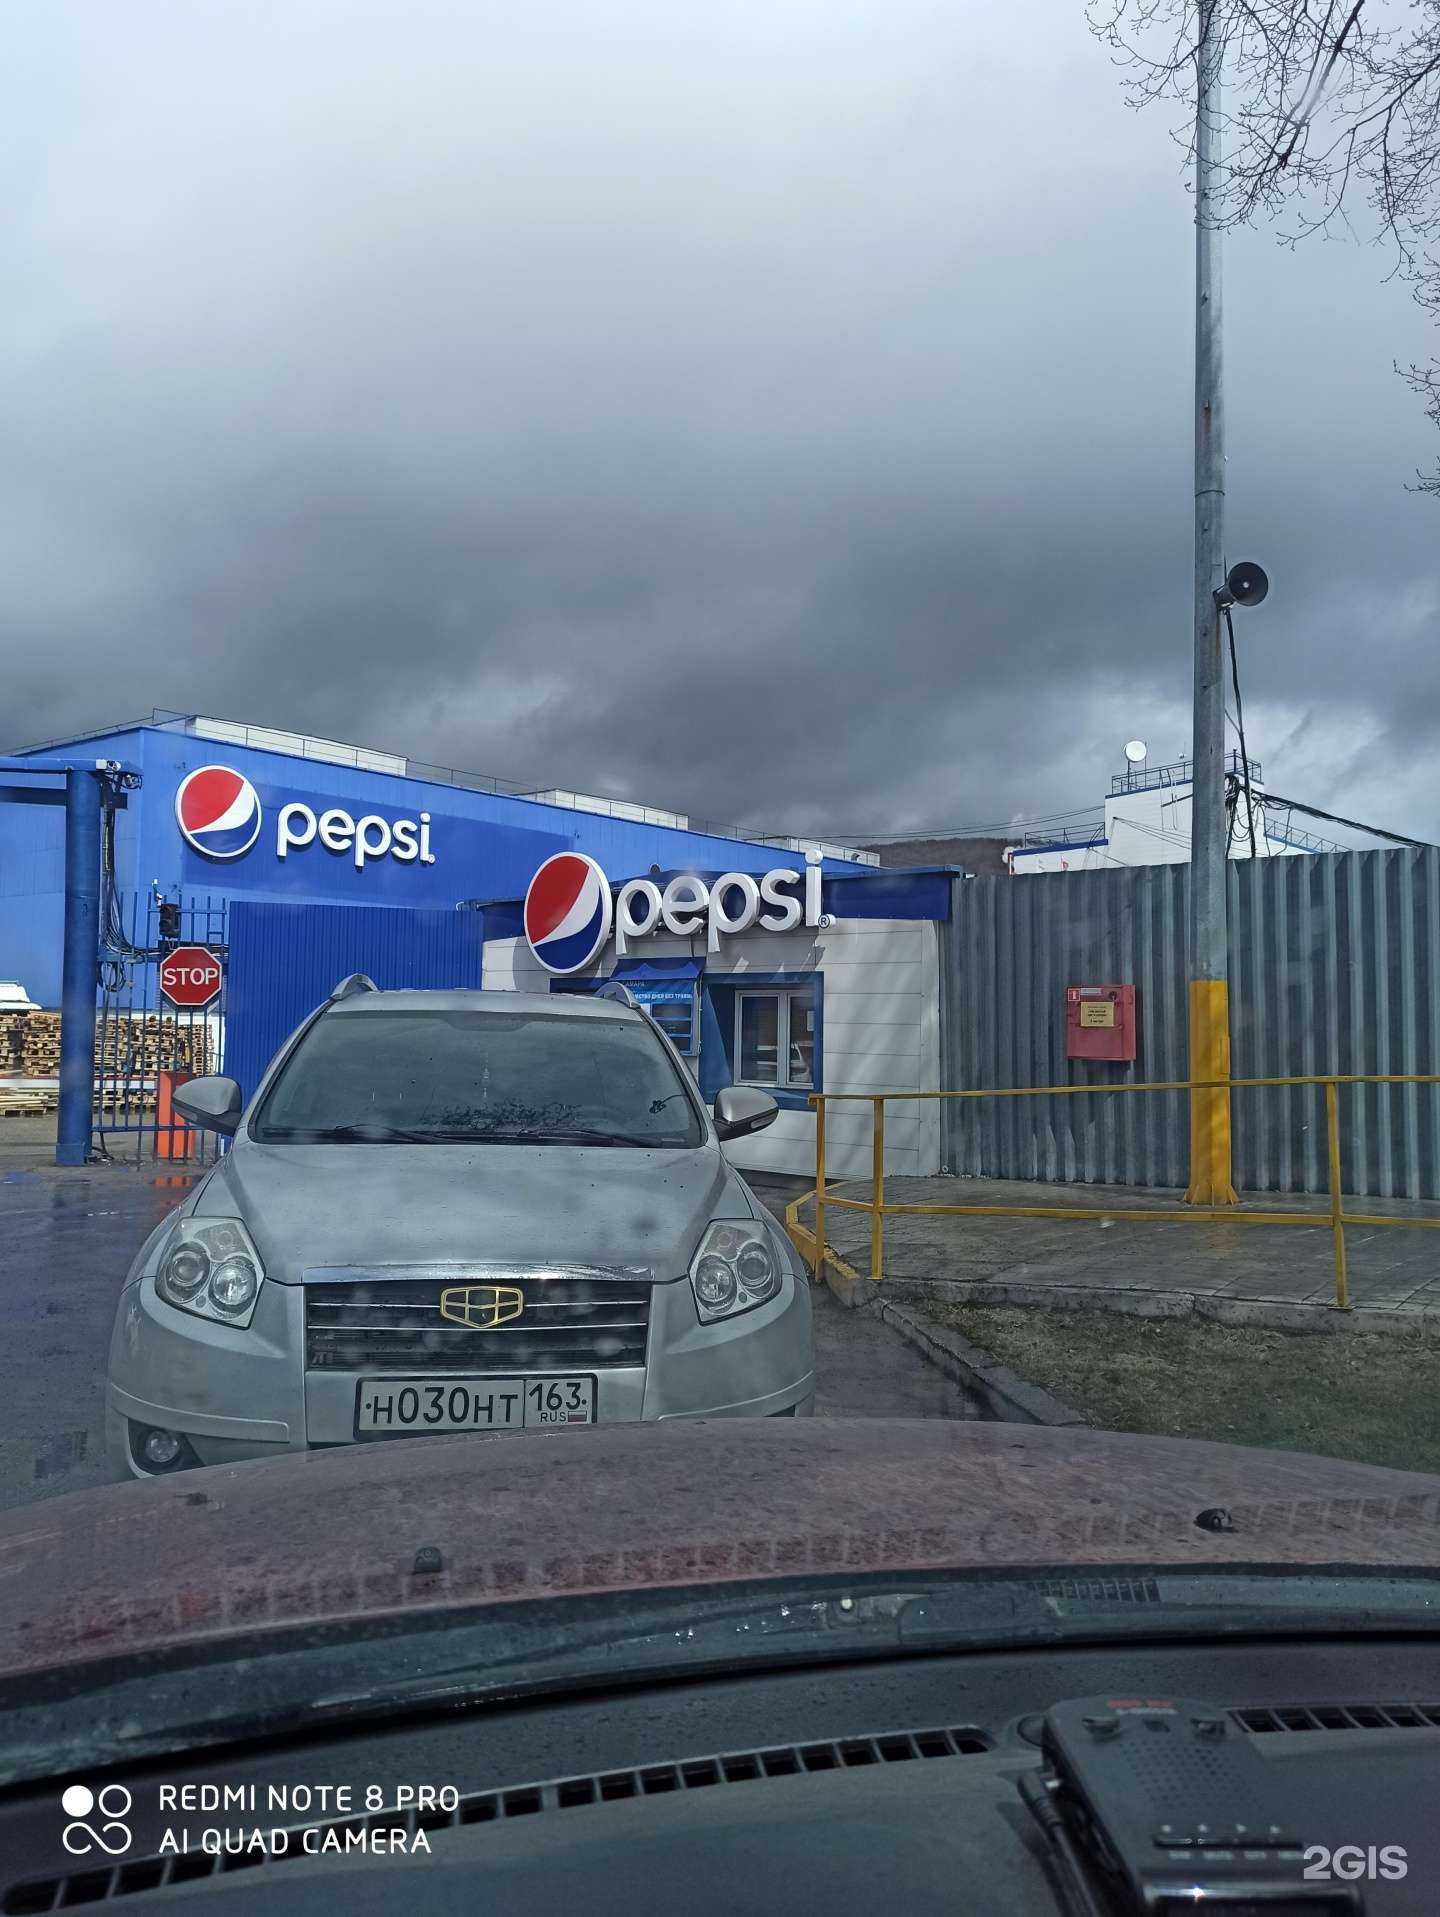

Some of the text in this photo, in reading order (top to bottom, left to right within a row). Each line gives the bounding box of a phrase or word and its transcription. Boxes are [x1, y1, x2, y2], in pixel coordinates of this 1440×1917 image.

[276, 802, 433, 868] pepsi
[615, 850, 824, 955] pepsi
[162, 967, 219, 987] STOP
[528, 1382, 582, 1411] 163
[540, 1412, 567, 1423] RUS
